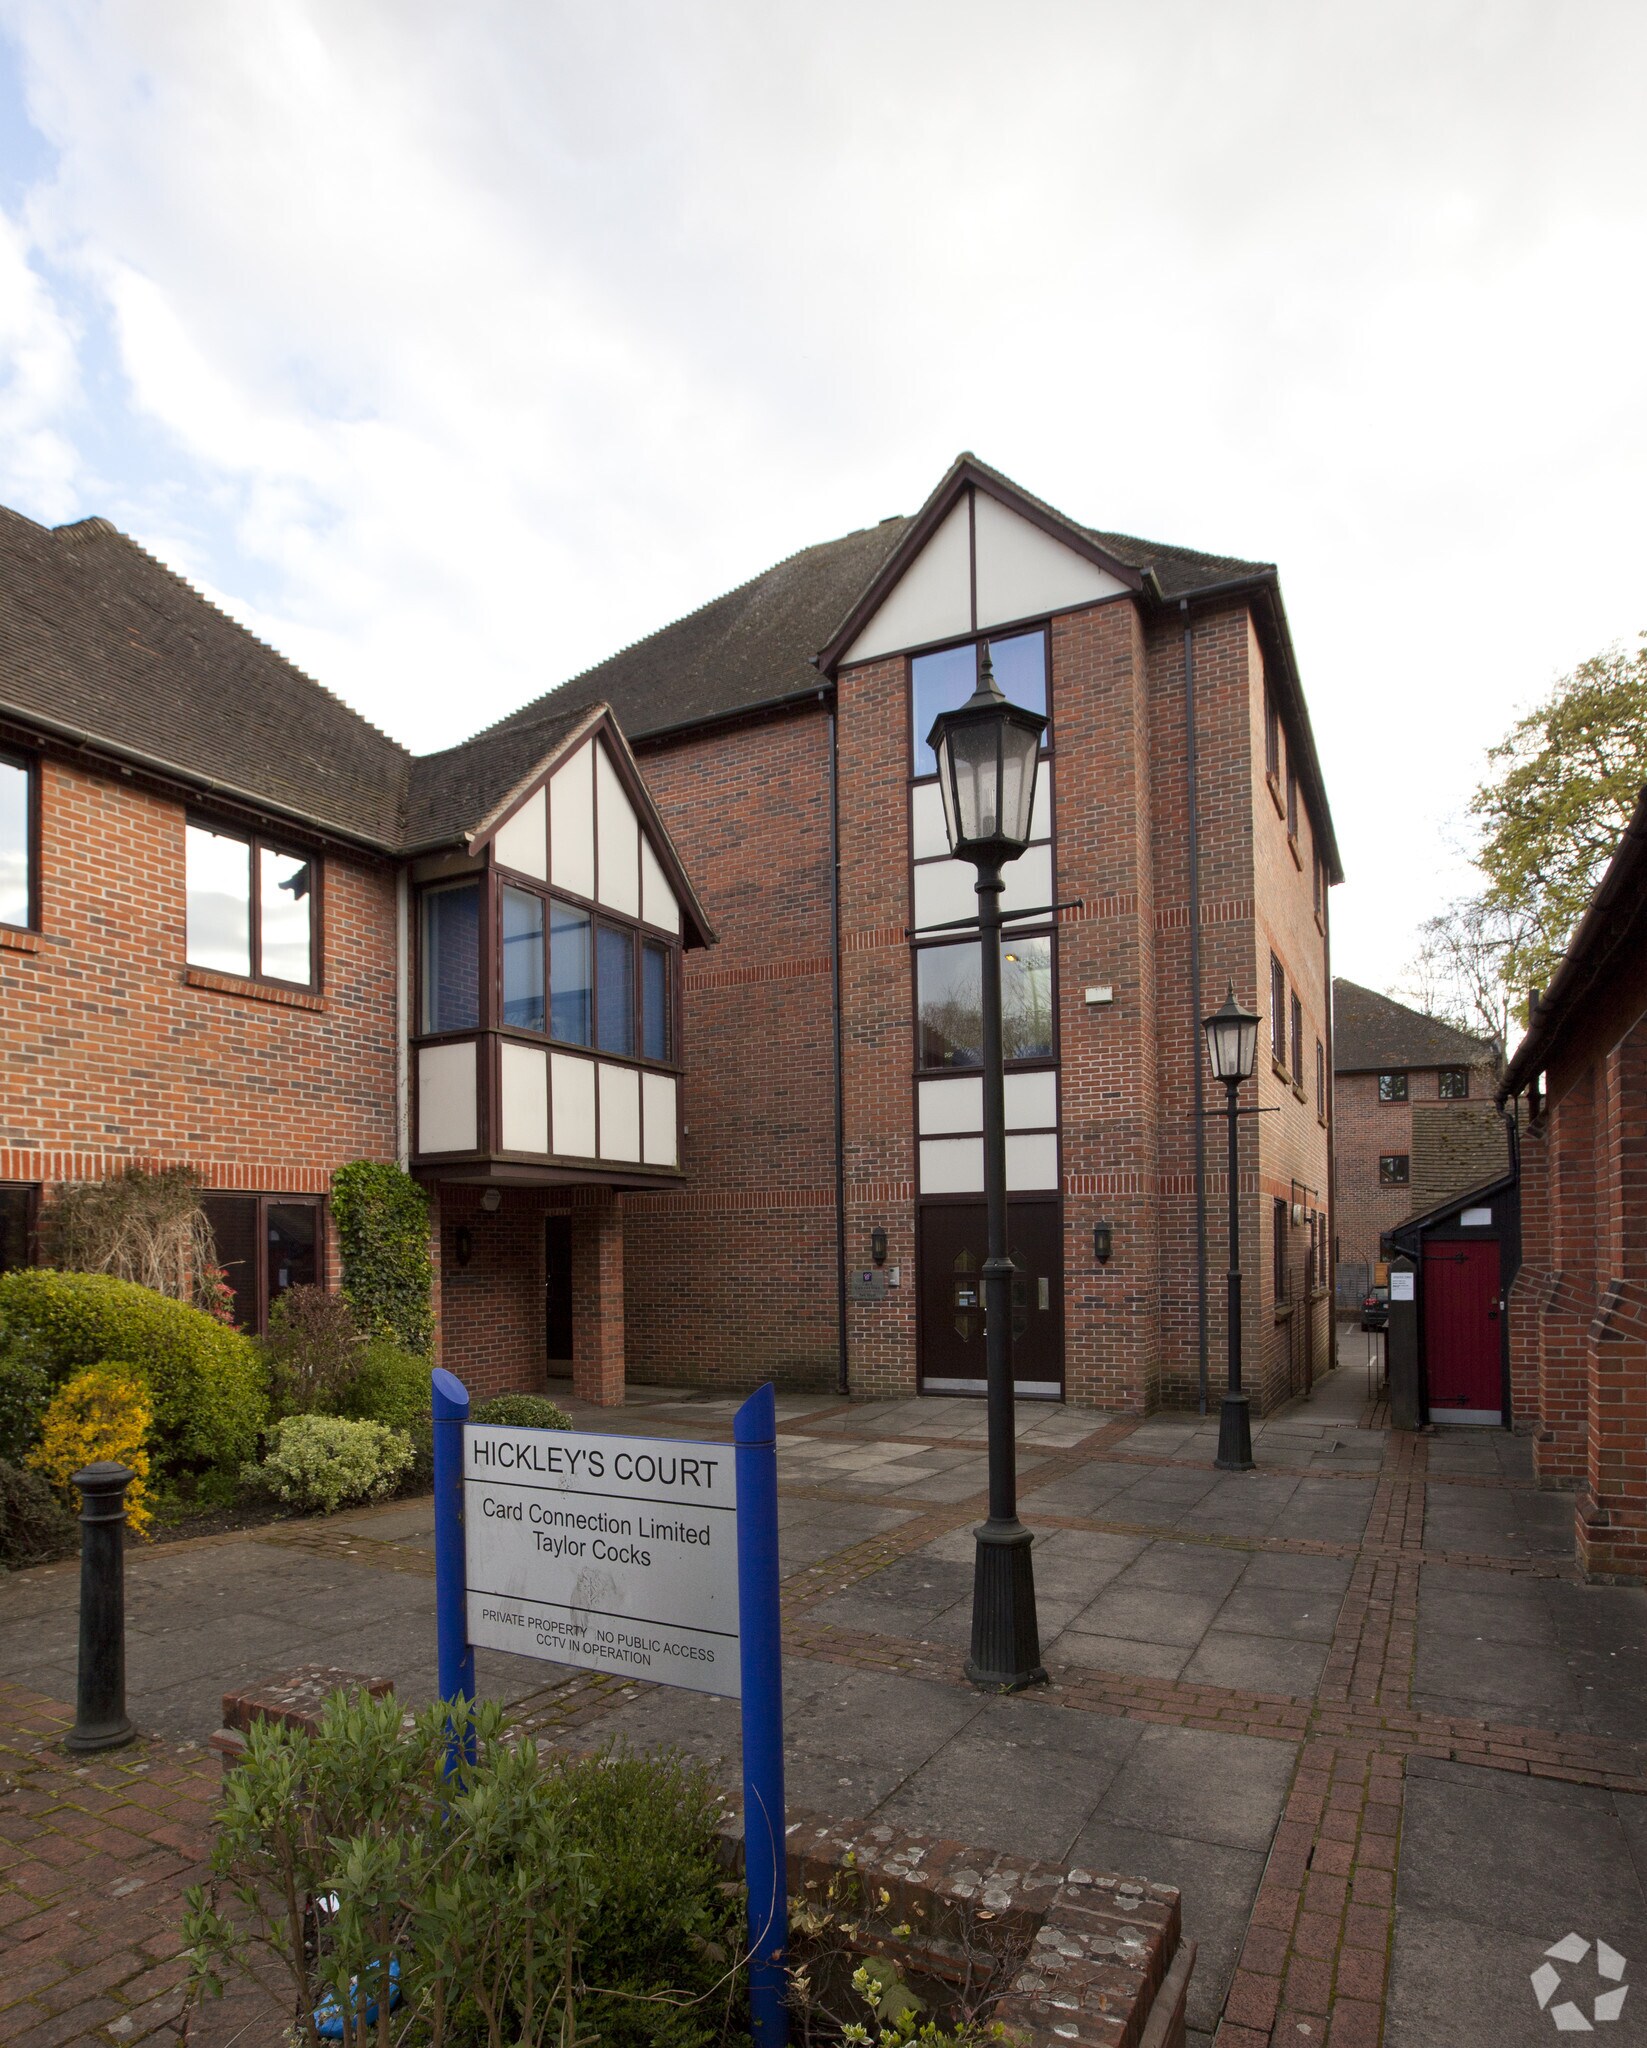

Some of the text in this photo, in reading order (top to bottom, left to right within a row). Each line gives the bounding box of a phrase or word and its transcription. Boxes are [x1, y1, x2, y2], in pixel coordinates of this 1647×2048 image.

[474, 1440, 719, 1489] HICKLEY'S COURT
[483, 1498, 711, 1546] Card Connection Limited
[533, 1530, 651, 1567] Taylor Cocks
[482, 1609, 715, 1663] PRIVATE PROPERTY NO PUBLIC ACCESS
[536, 1633, 651, 1666] CCTV IN OPERATION
